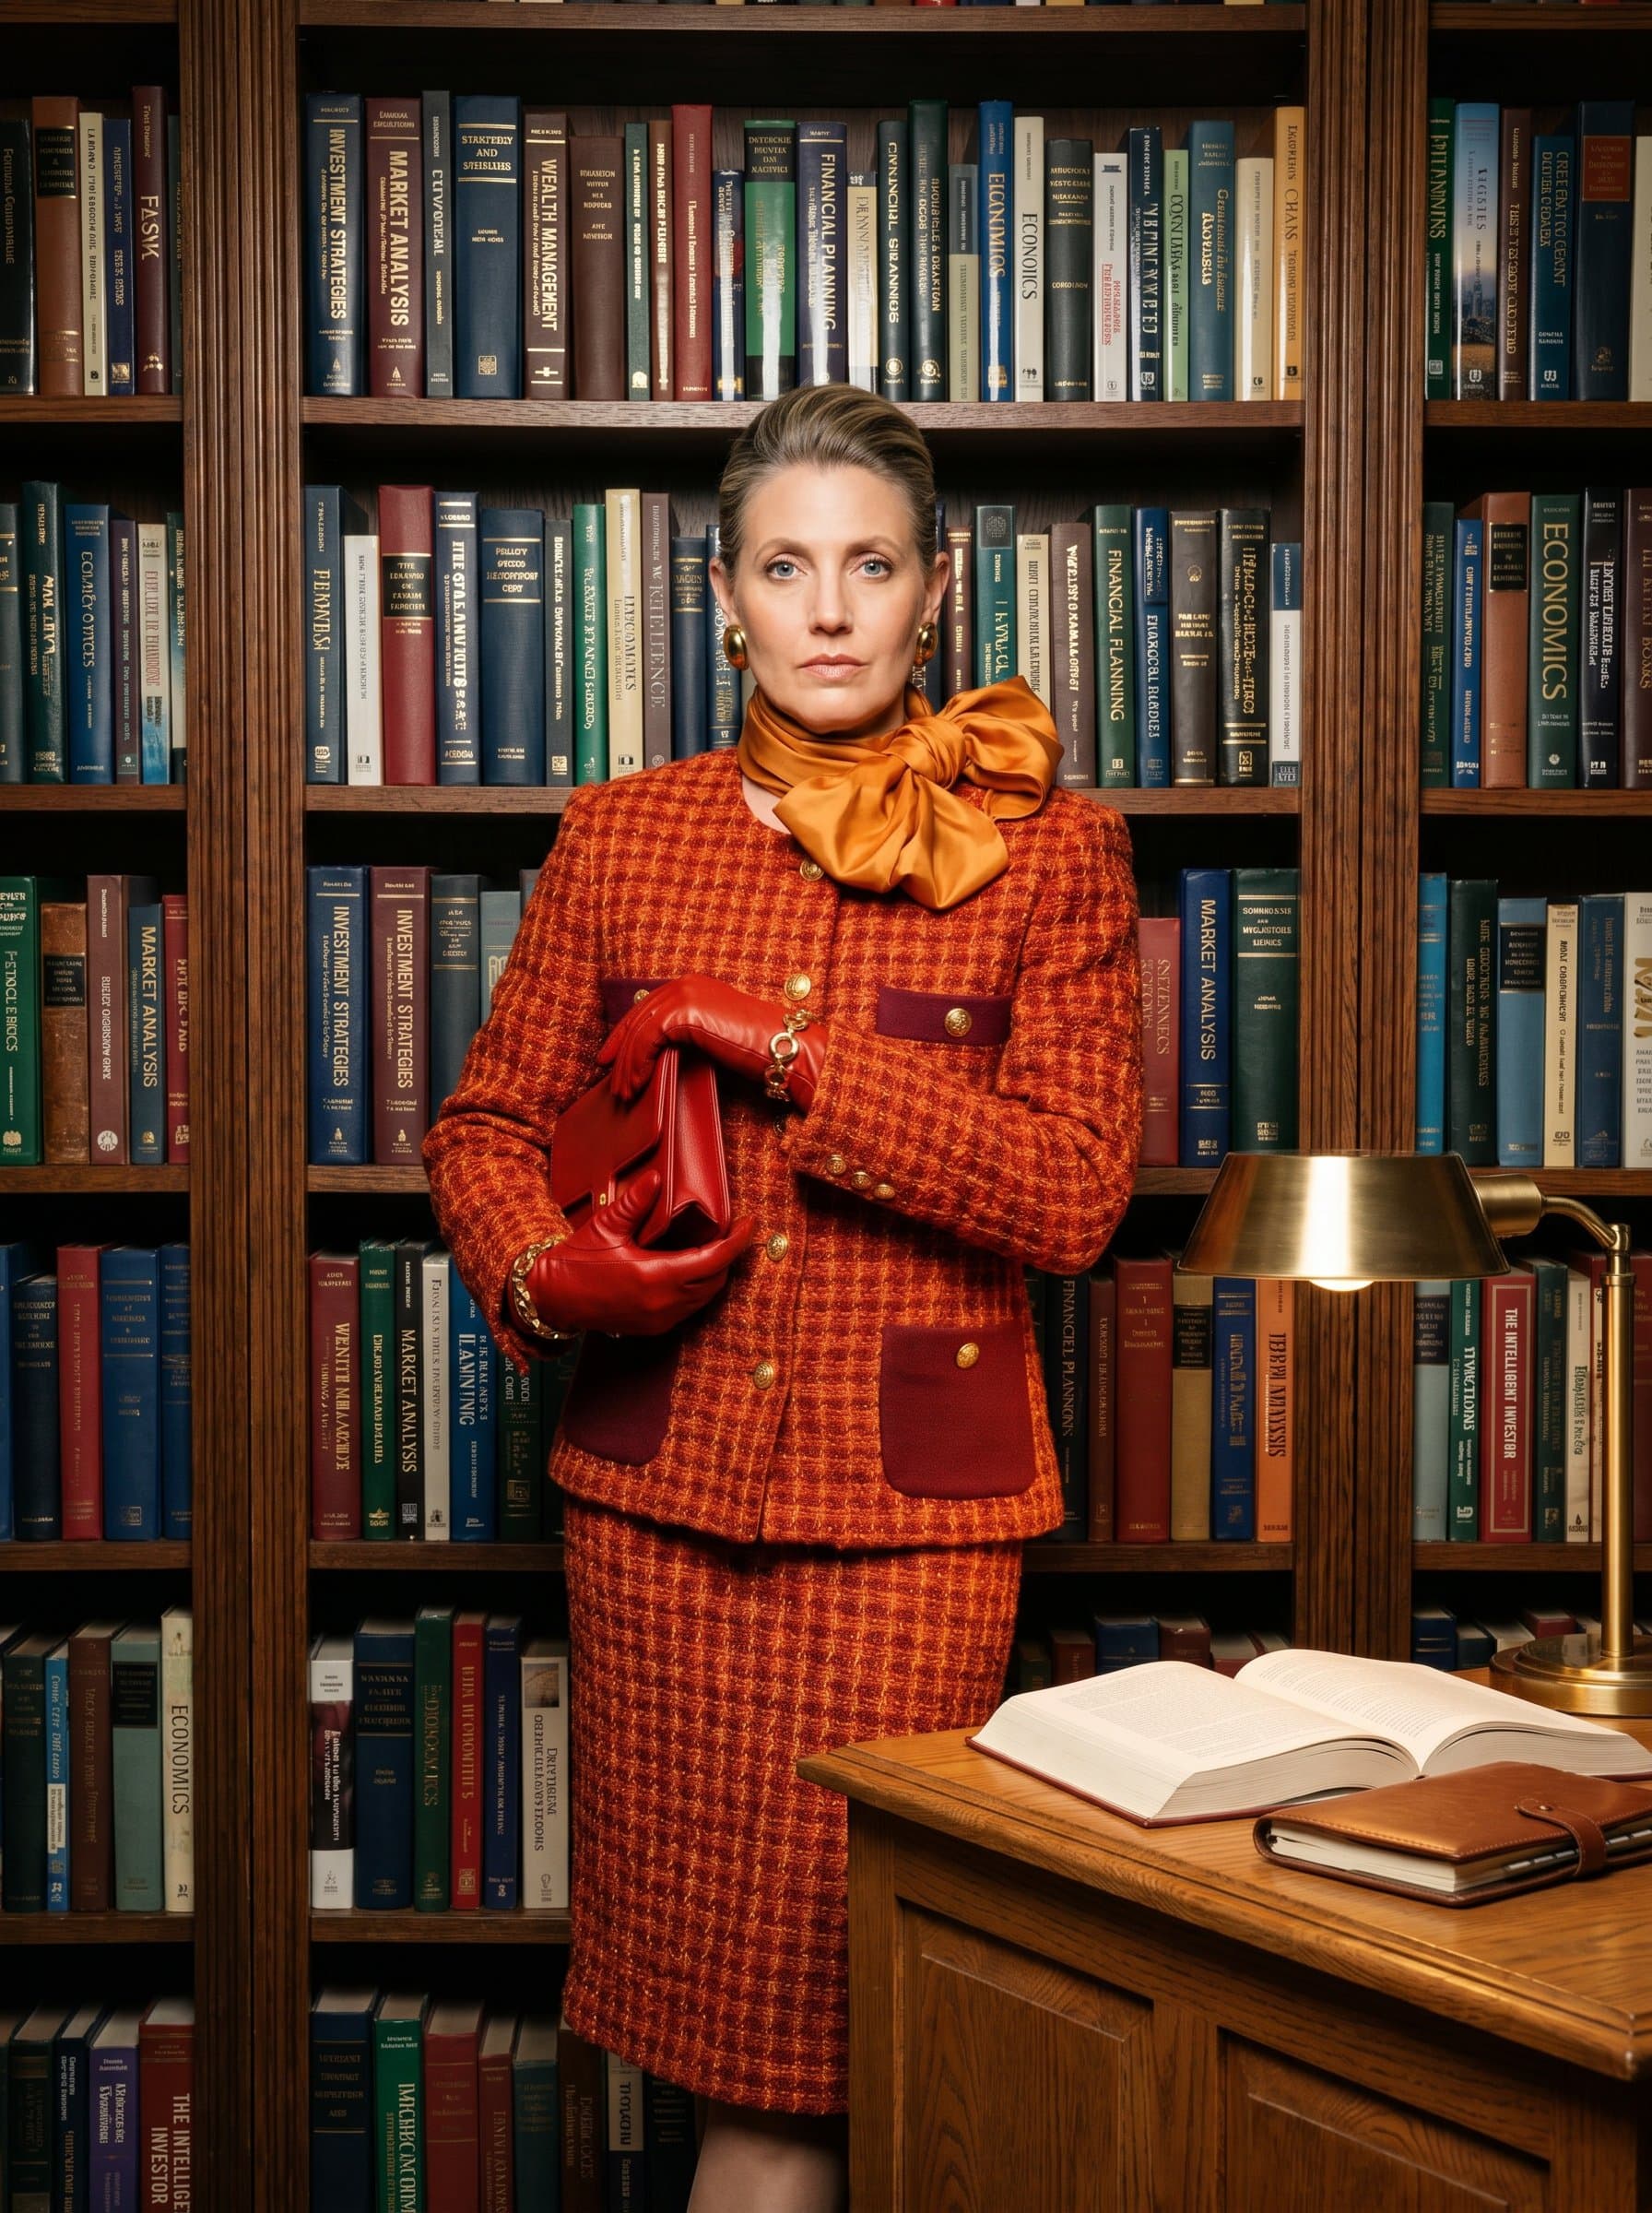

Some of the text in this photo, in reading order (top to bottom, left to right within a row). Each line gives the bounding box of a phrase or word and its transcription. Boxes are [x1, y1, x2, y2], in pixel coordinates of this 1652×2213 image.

[329, 128, 347, 319] INVESTMENT STRATEGIES
[476, 148, 498, 158] AND
[389, 150, 409, 326] MARKET ANALYSIS
[540, 159, 558, 332] WEALTH MANAGEMENT
[821, 153, 836, 331] FINANCIAL PLANNING
[1108, 550, 1123, 634] FINANCIAL
[1542, 522, 1569, 701] ECONOMICS
[142, 926, 158, 1088] MARKET ANALYSIS
[333, 905, 349, 1087] INVESTMENT STRATEGIES
[397, 909, 413, 1089] INVESTMENT STRATEGIES
[1200, 899, 1216, 1061] MARKET ANALYSIS
[1504, 1308, 1517, 1329] THE
[401, 1330, 417, 1473] MARKET ANALYSIS
[171, 1704, 189, 1816] ECONOMICS
[150, 2126, 168, 2205] INVESTOR
[173, 2092, 190, 2124] THE
